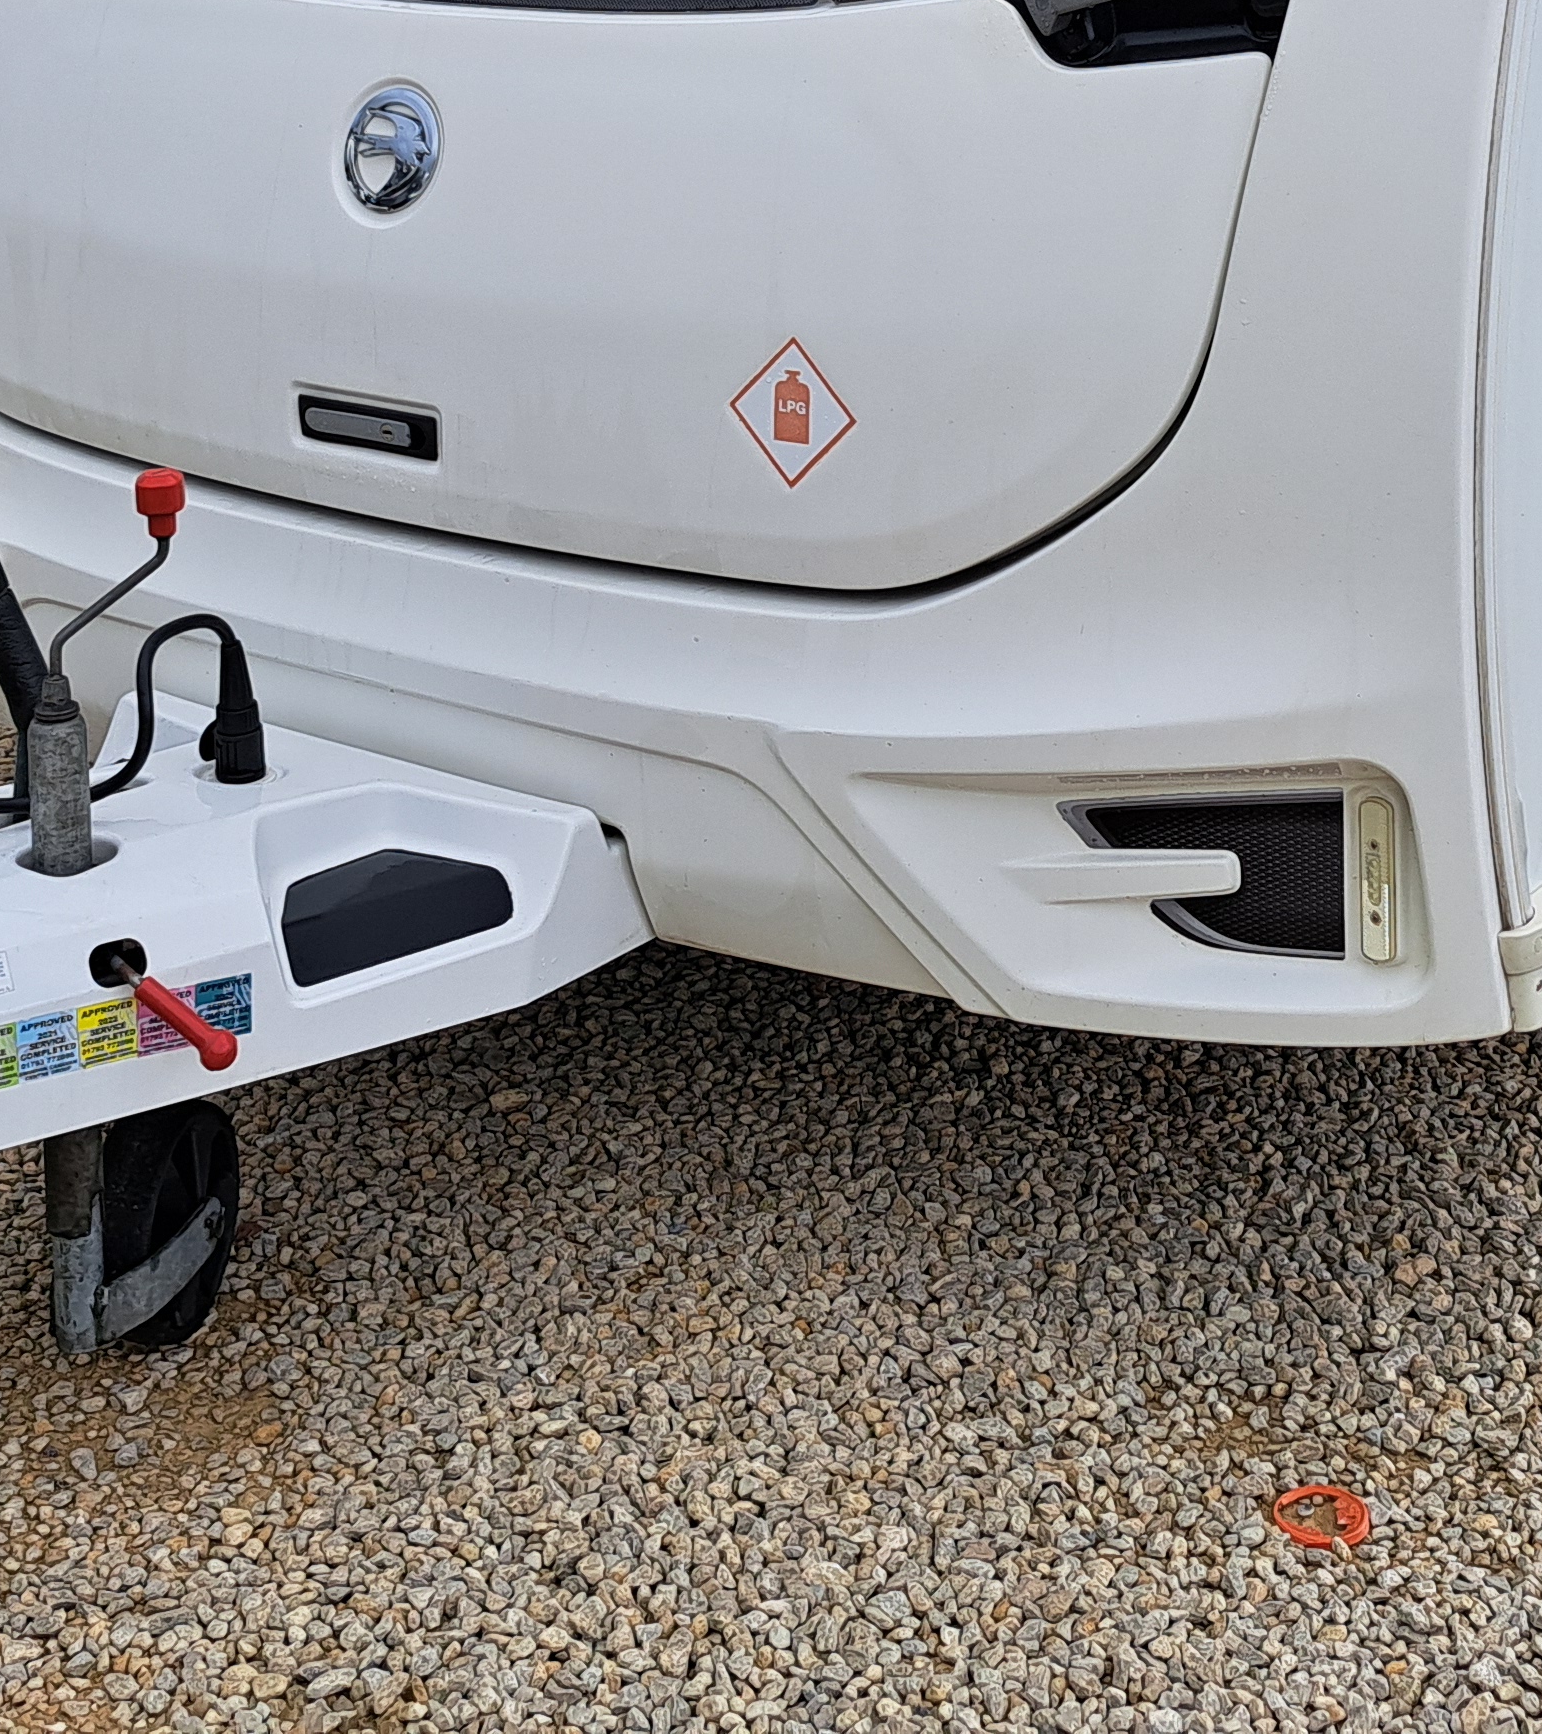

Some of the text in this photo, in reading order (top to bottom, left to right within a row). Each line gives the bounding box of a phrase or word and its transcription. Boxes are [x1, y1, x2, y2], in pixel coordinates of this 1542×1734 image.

[778, 398, 807, 415] LPG
[81, 1001, 133, 1019] APPROVED
[20, 1015, 74, 1033] APPROVED
[140, 1022, 172, 1036] COMPL
[29, 1035, 66, 1051] SERVICE
[20, 1042, 77, 1062] COMPLETED
